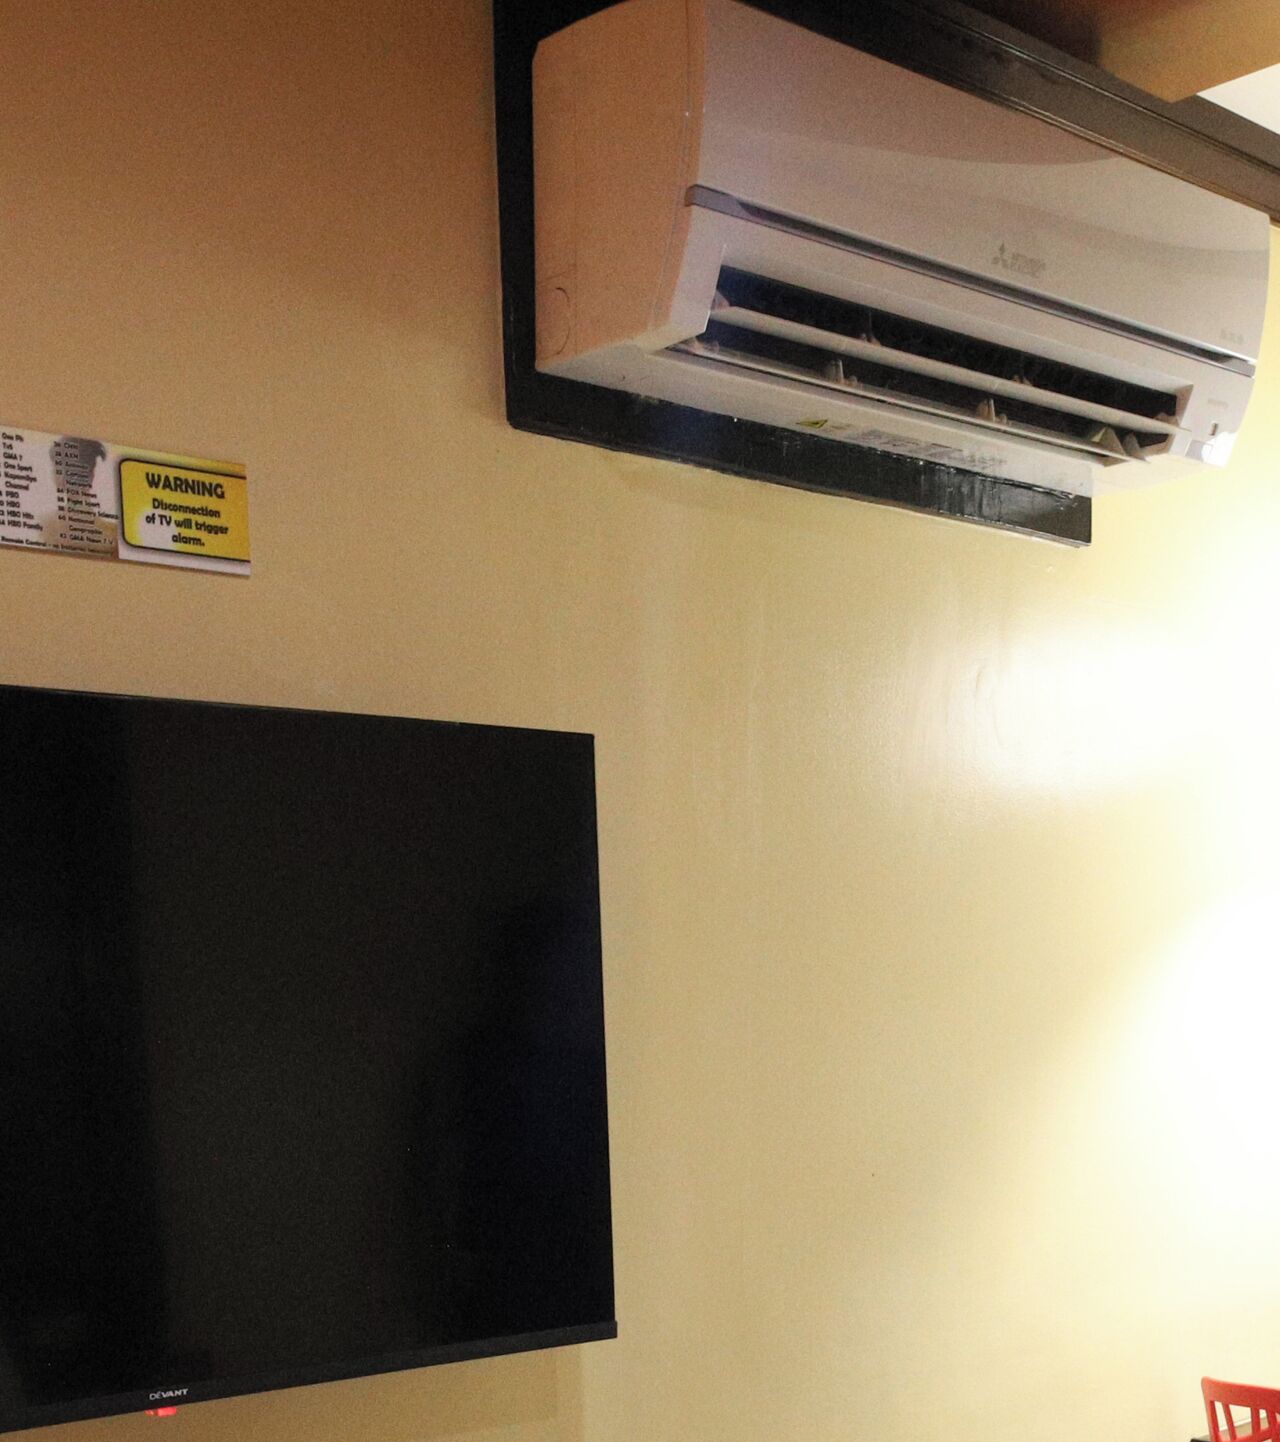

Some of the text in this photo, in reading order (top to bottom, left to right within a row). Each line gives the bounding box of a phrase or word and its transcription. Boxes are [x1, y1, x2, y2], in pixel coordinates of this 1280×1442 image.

[145, 472, 225, 499] WARNING
[152, 498, 221, 518] Disconnection
[145, 513, 229, 535] of TV will trigger
[171, 533, 206, 547] alarm.
